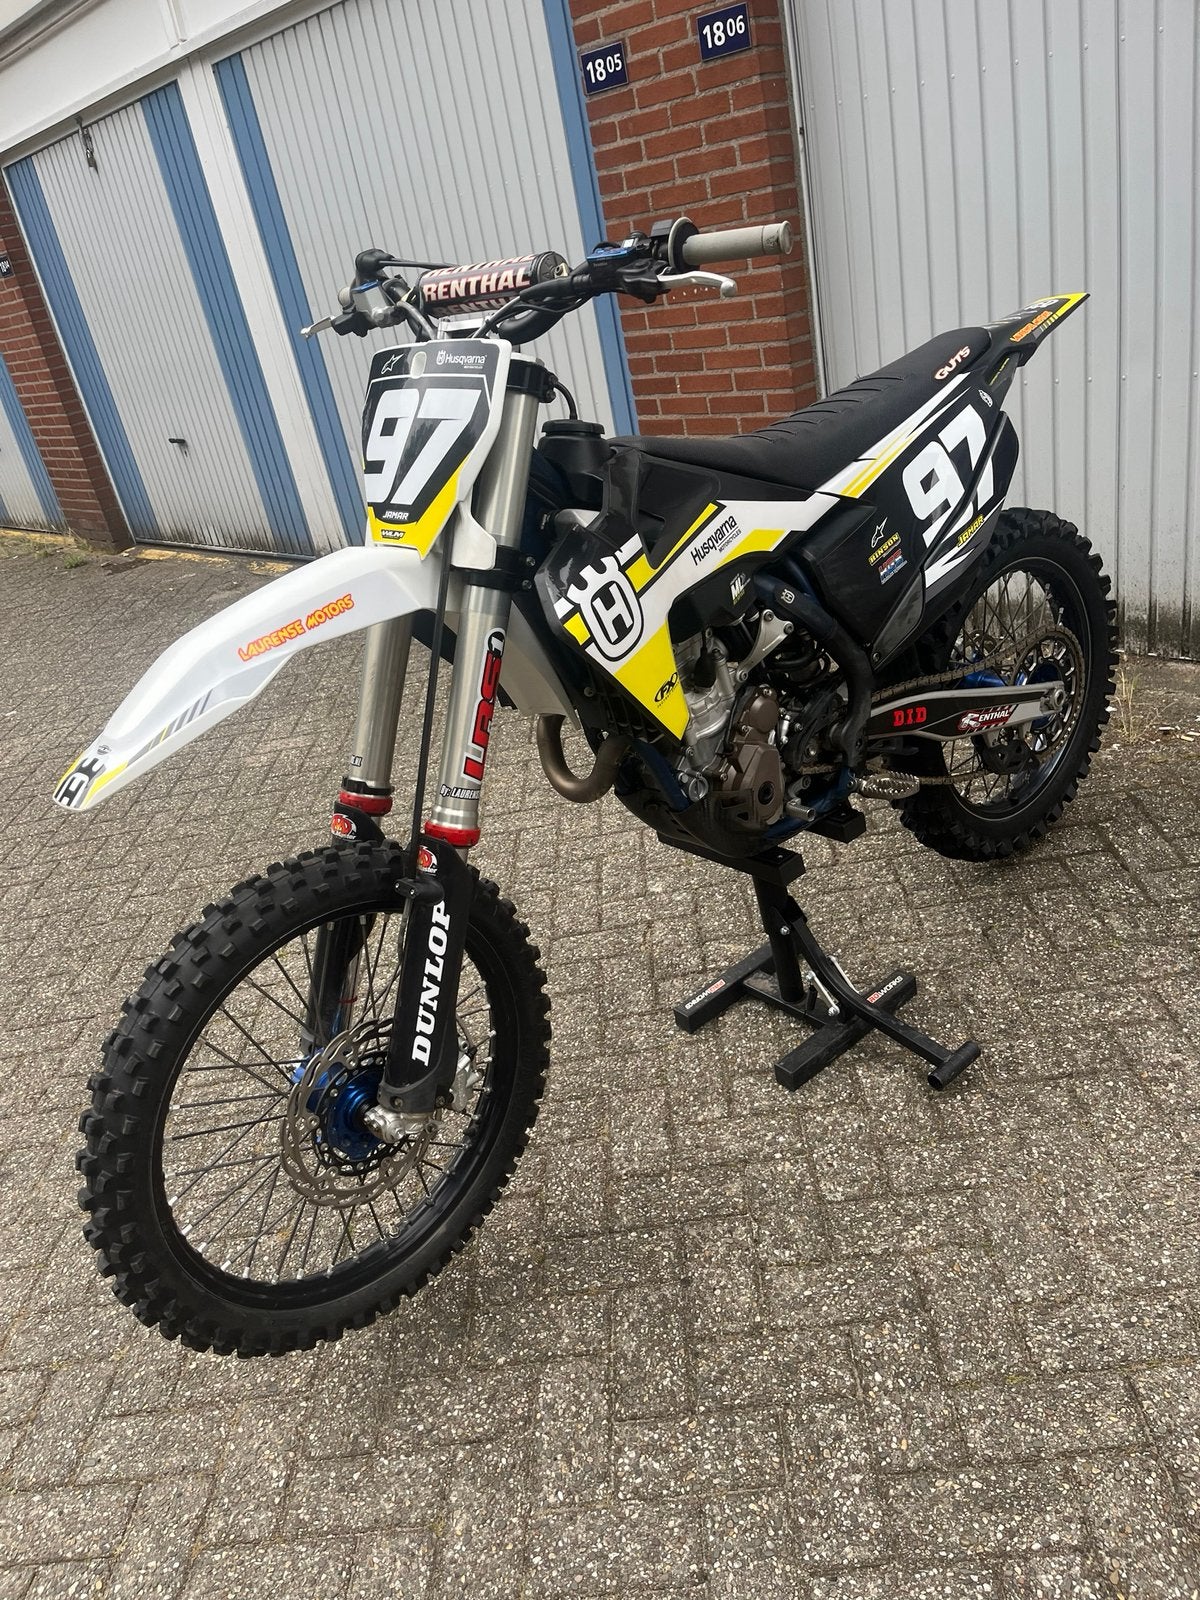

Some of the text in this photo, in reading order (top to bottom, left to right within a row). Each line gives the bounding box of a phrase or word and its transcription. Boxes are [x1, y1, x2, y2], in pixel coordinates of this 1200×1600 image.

[702, 14, 746, 49] 1806
[586, 53, 622, 84] 1805
[422, 267, 531, 303] RENTHAL
[444, 353, 486, 366] Husqvarna
[934, 345, 971, 380] GUTS
[364, 388, 482, 506] 97
[902, 404, 994, 548] 97
[382, 510, 409, 521] JAMAR
[956, 514, 985, 548] JAMAR
[690, 515, 738, 567] Husqvarna
[238, 593, 355, 662] LAURENSE MOTORS
[411, 900, 451, 1067] DUNLOP
[866, 975, 904, 1004] ROWORKS
